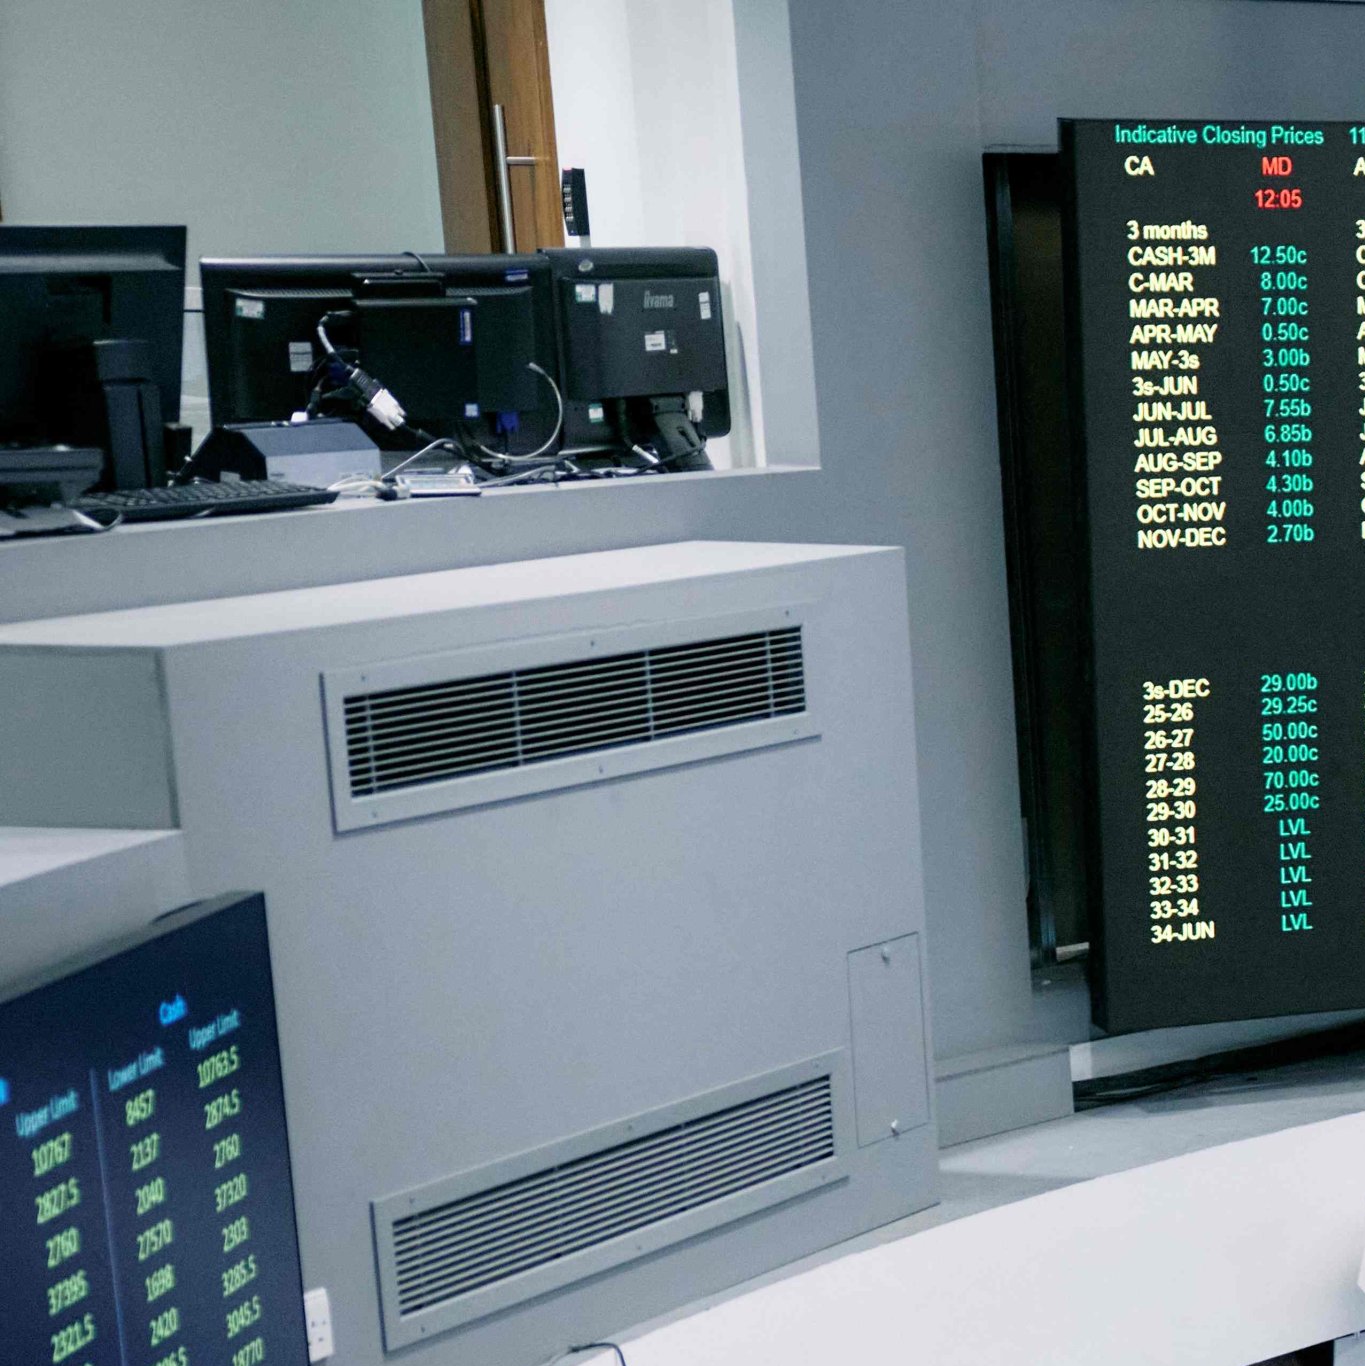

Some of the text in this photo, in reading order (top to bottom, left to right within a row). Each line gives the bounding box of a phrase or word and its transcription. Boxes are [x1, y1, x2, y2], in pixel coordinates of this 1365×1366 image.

[1115, 124, 1198, 145] Indicative
[1201, 124, 1267, 149] Closing
[1271, 125, 1325, 145] Prices
[1124, 156, 1292, 176] CA MD
[1255, 189, 1302, 209] 12:05
[1127, 220, 1208, 240] 3 months
[1127, 246, 1307, 266] CASH-3M 12.50c
[1128, 272, 1307, 292] C-MAR 8.00c
[1129, 297, 1308, 318] MAR-APR 7.00c
[1129, 323, 1309, 344] APR-MAY 0.50c
[1131, 348, 1310, 370] MAY-3s 3.00b
[1132, 374, 1310, 396] 3s-JUN 0.50c
[1133, 399, 1311, 421] JUN-JUL 7.55b
[1134, 424, 1312, 447] JUL-AUG 6.85b
[1134, 449, 1312, 473] AUG-SEP 4.10b
[1136, 474, 1313, 498] SEP-OCT 4.30b
[1136, 499, 1314, 523] OCT-NOV 4.00b
[1137, 524, 1314, 549] NOV-DEC 2.70b
[1143, 673, 1318, 700] 3s-DEC 29.00b
[1151, 921, 1215, 943] 34-JUN
[107, 1008, 242, 1092] Lower Limit Upper Limit
[15, 1104, 49, 1138] Upper
[50, 1088, 80, 1121] Limit
[214, 1133, 240, 1169] 2760
